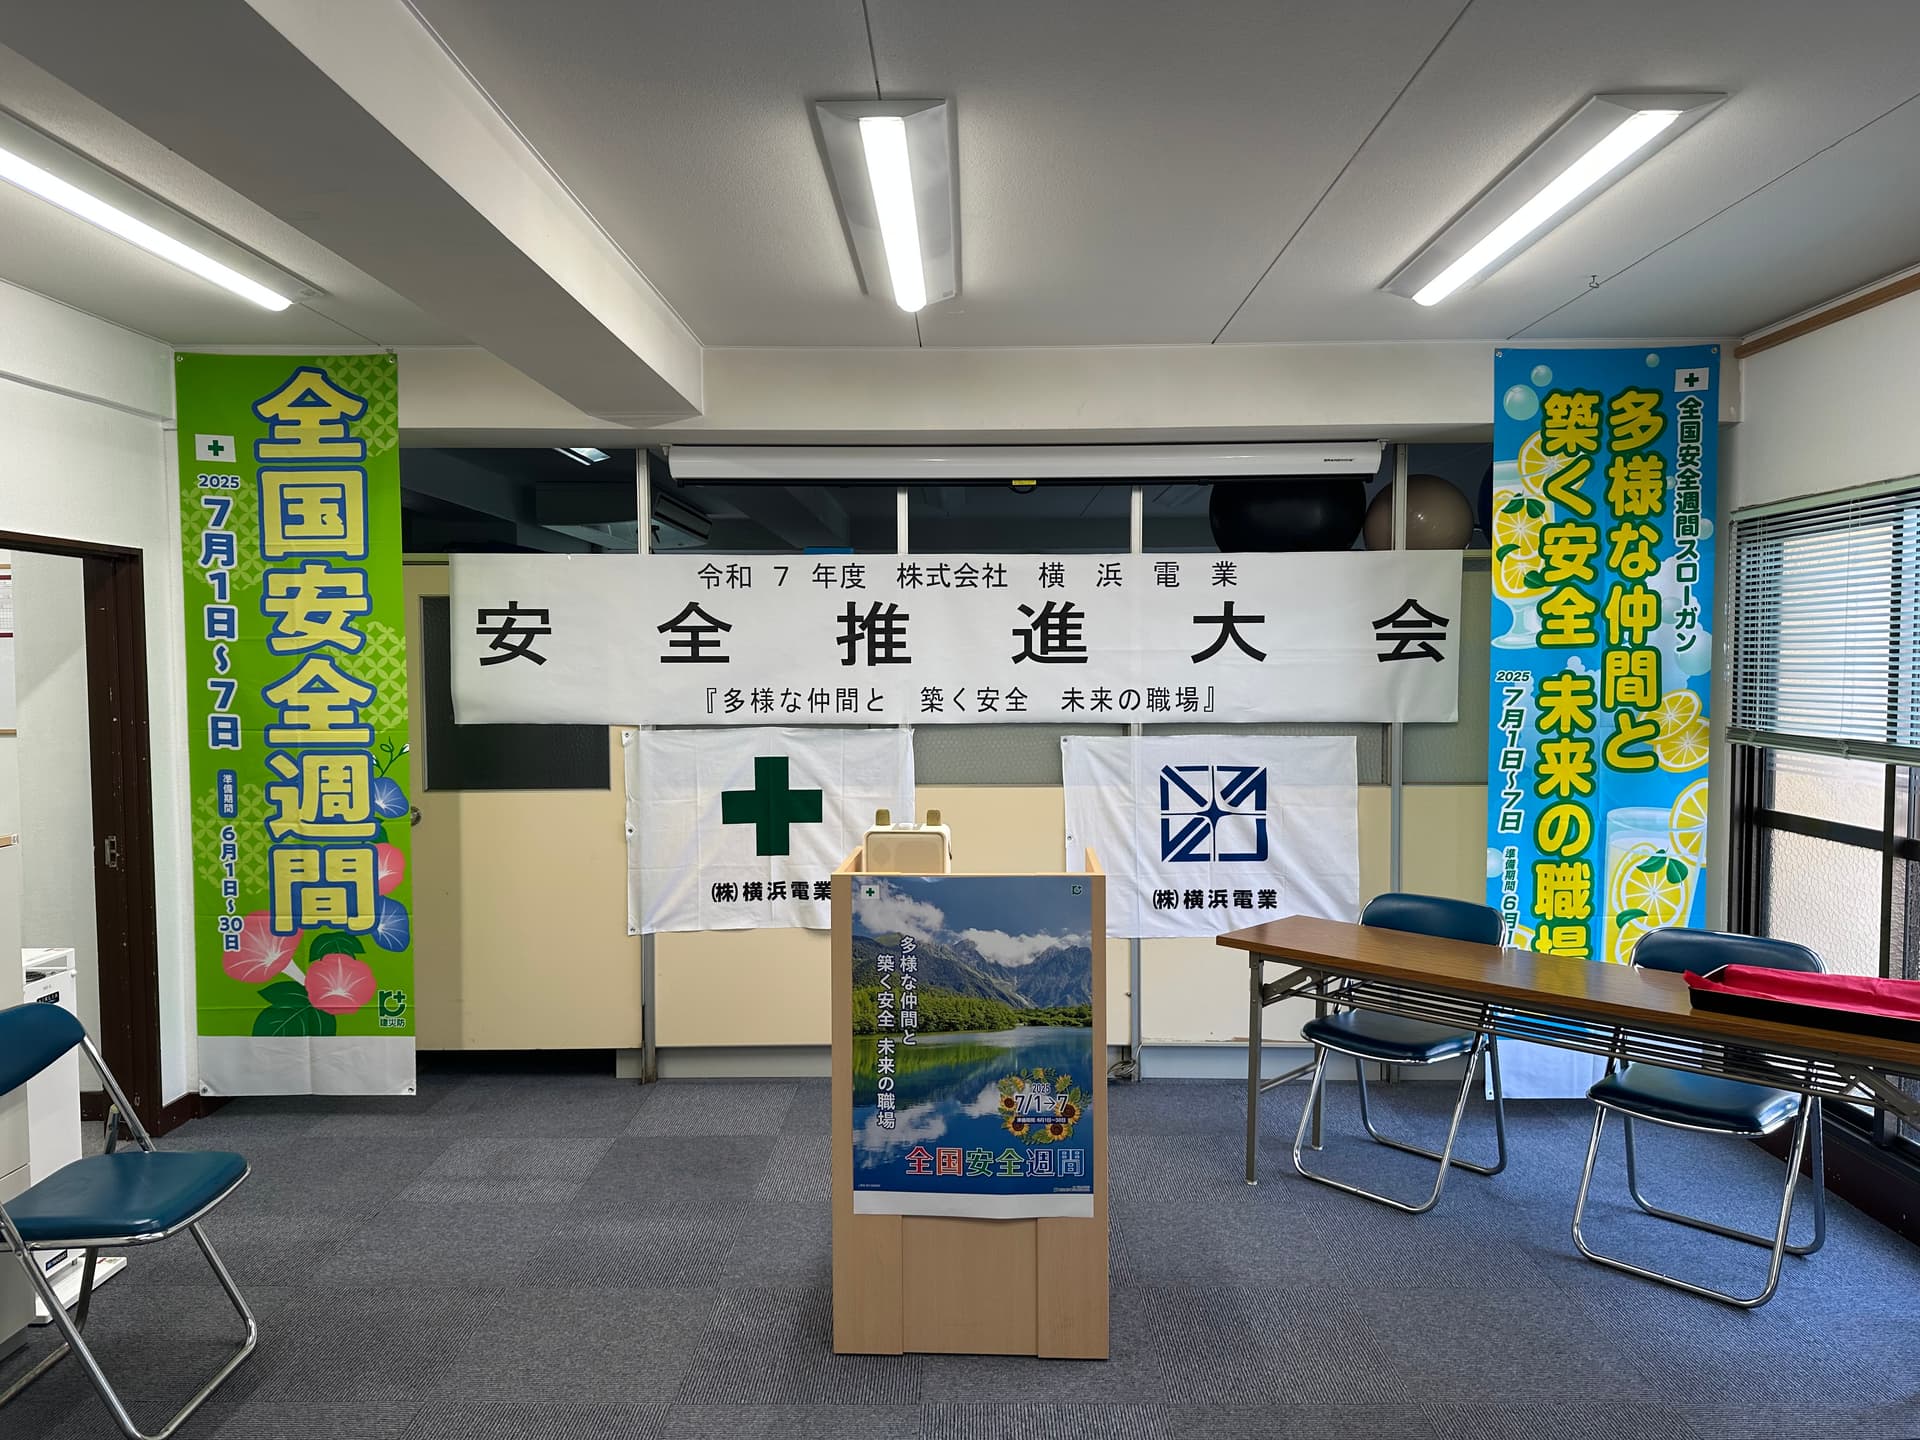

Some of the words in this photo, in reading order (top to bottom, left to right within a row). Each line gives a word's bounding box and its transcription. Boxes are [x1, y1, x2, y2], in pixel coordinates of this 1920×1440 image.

[199, 475, 240, 489] 2025
[1537, 387, 1603, 648] 築く安全
[1675, 397, 1703, 652] 全国安全週間スローガン
[897, 562, 1008, 588] 株式会社
[1601, 387, 1667, 771] 多様な仲間と
[253, 366, 381, 936] 全国安全週間
[1496, 671, 1530, 682] 2025
[706, 687, 885, 714] 『多様な仲間と
[920, 686, 1028, 713] 築く安全
[1061, 685, 1215, 713] 未来の職場』
[877, 954, 896, 1028] 築く安全
[899, 936, 918, 1046] 多様な仲間と
[876, 1037, 896, 1130] 未来の職場
[905, 1146, 1085, 1178] 全国安全週間
